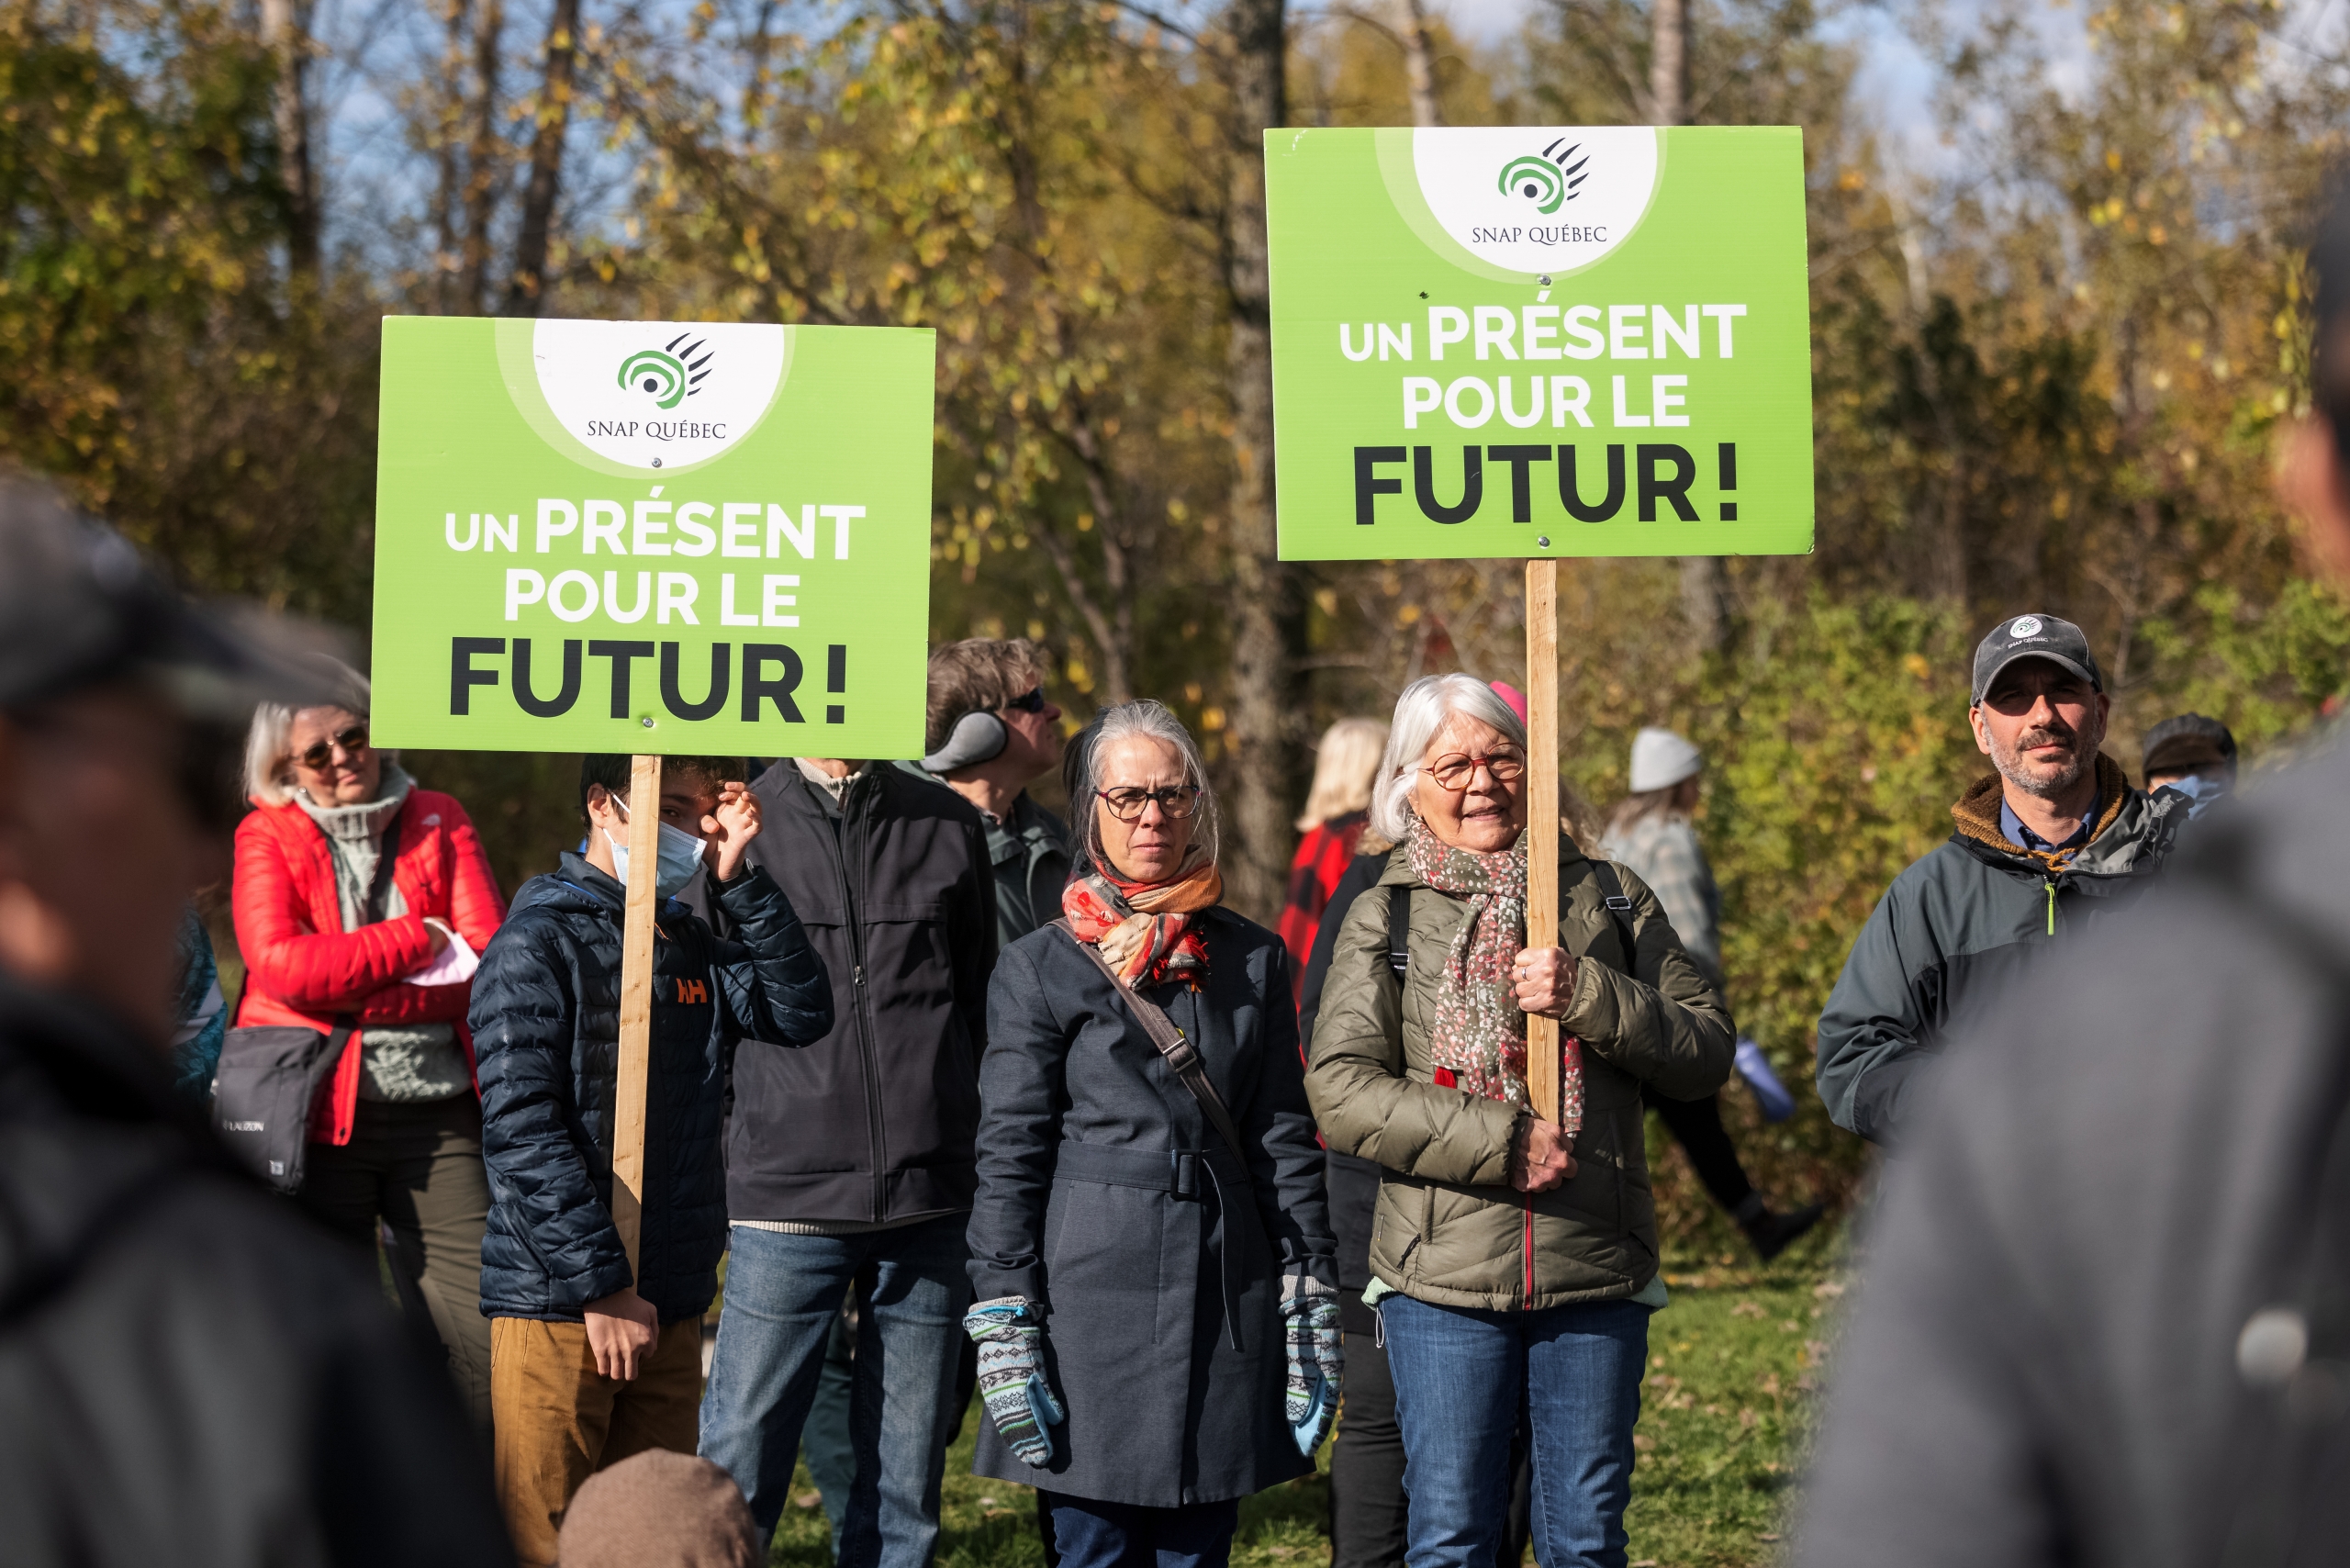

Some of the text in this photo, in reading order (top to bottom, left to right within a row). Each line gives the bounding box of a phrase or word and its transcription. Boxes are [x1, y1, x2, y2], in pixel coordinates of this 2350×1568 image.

[1472, 224, 1607, 246] SNAP QUÉBEC
[1339, 290, 1747, 362] UN PRÉSENT
[587, 420, 726, 442] SNAP QUÉBEC
[1403, 375, 1691, 430] POUR LE
[445, 486, 867, 560] UN PRÉSENT
[505, 568, 800, 628] POUR LE
